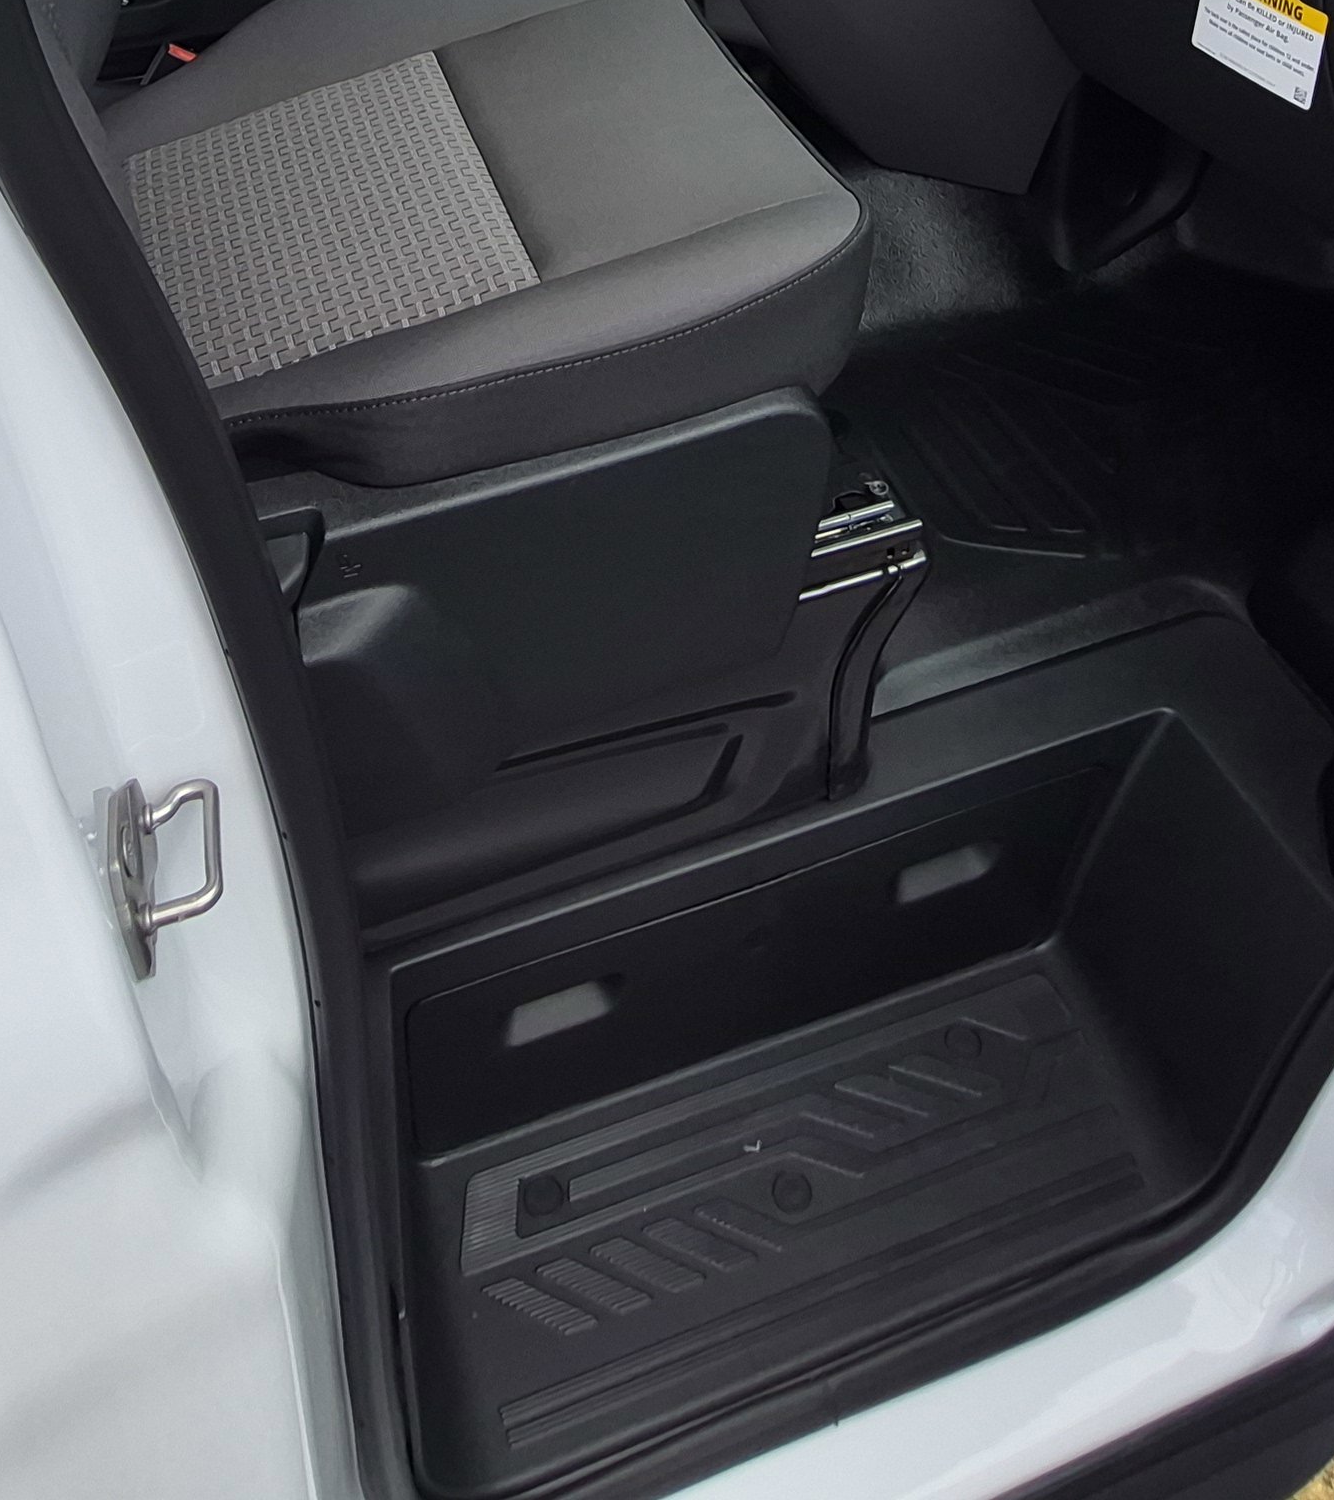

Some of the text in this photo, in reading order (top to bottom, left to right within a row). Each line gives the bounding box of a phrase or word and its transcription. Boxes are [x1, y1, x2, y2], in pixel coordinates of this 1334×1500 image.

[1256, 7, 1278, 23] KILLED
[1277, 19, 1286, 27] or
[1286, 23, 1315, 42] INJURED
